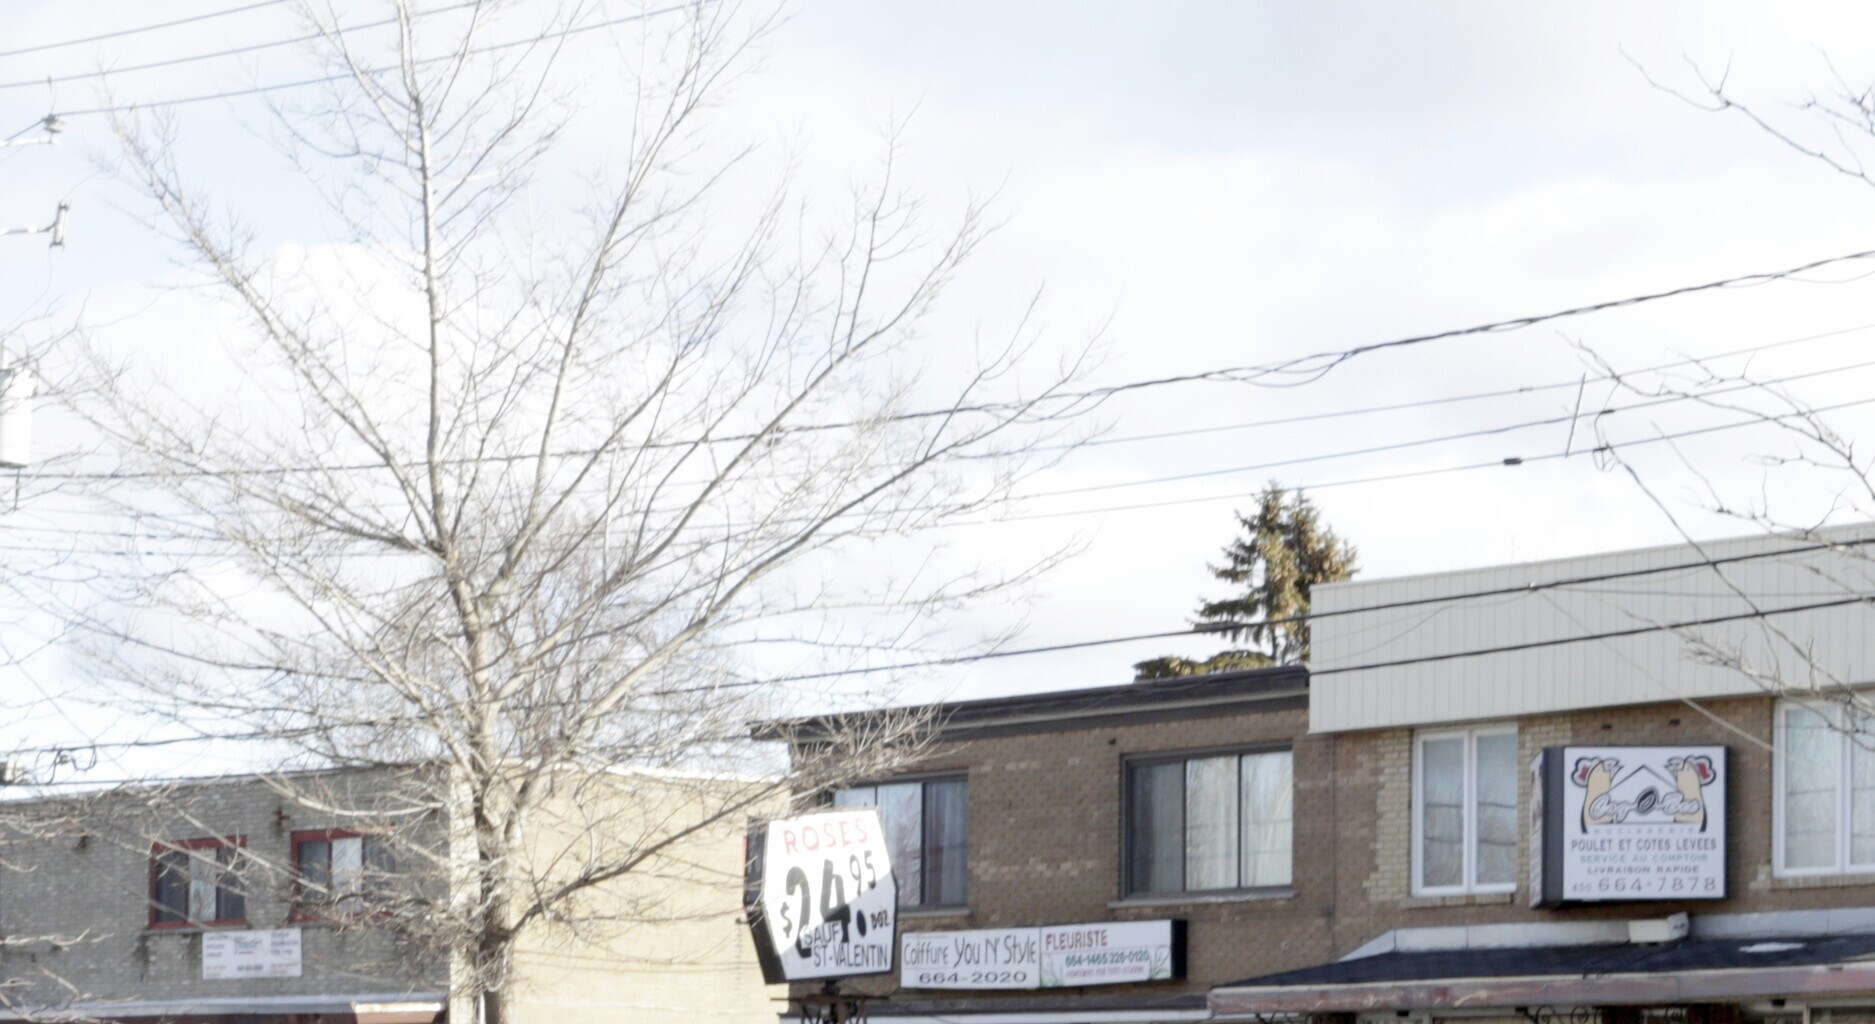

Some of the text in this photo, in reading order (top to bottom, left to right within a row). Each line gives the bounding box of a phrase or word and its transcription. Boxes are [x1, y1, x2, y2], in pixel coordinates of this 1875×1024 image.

[783, 818, 868, 854] ROSES
[1571, 839, 1613, 852] POULET
[1619, 838, 1632, 851] ET
[1580, 852, 1708, 864] SERVICE AU COMPTOIR
[1587, 865, 1699, 875] LIVRAISON RAPIDE
[1598, 877, 1716, 892] 664-7878
[804, 922, 841, 947] SAUF
[1045, 929, 1108, 951] FLEURISTE
[813, 945, 888, 968] ST-VALENTIN
[918, 972, 1027, 984] 664-2020
